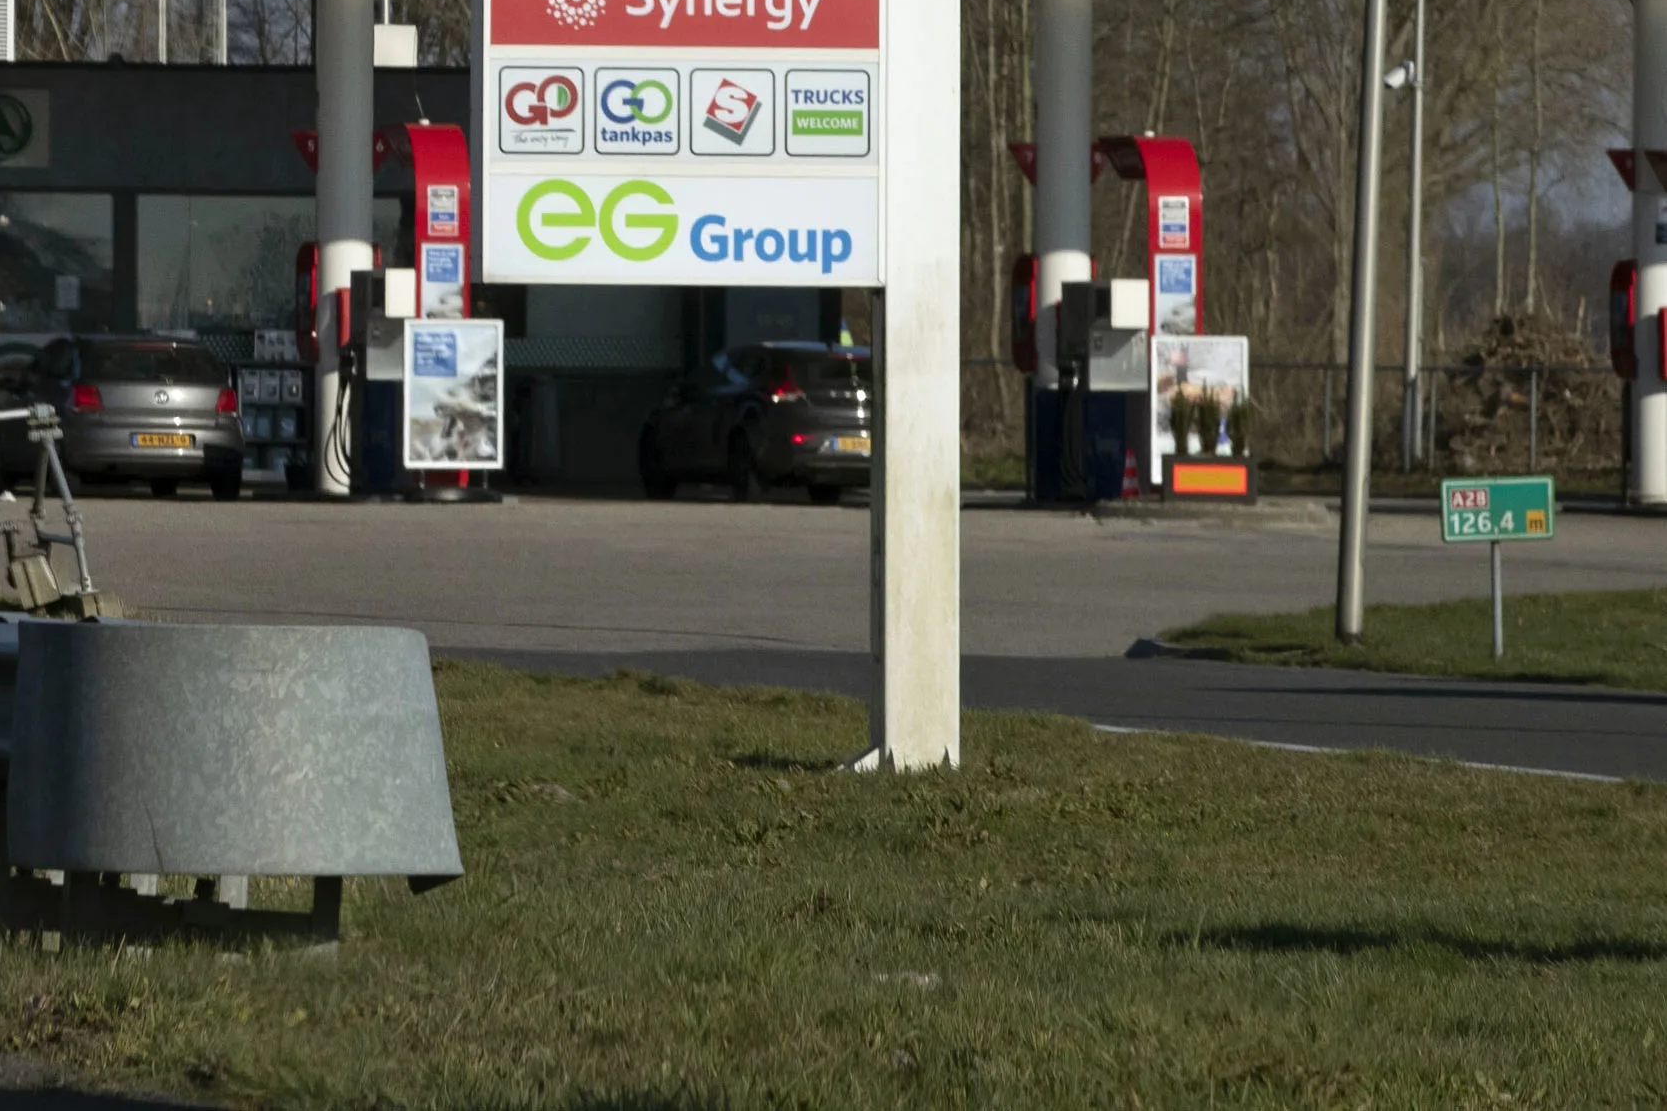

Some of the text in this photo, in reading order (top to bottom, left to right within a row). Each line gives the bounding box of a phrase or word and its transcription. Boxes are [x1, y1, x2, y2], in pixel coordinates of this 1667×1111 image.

[600, 79, 673, 125] GO
[791, 89, 865, 105] TRUCKS
[796, 116, 859, 130] WELCOME
[600, 126, 674, 147] tankpas
[688, 214, 853, 274] Group
[1452, 490, 1487, 508] A28
